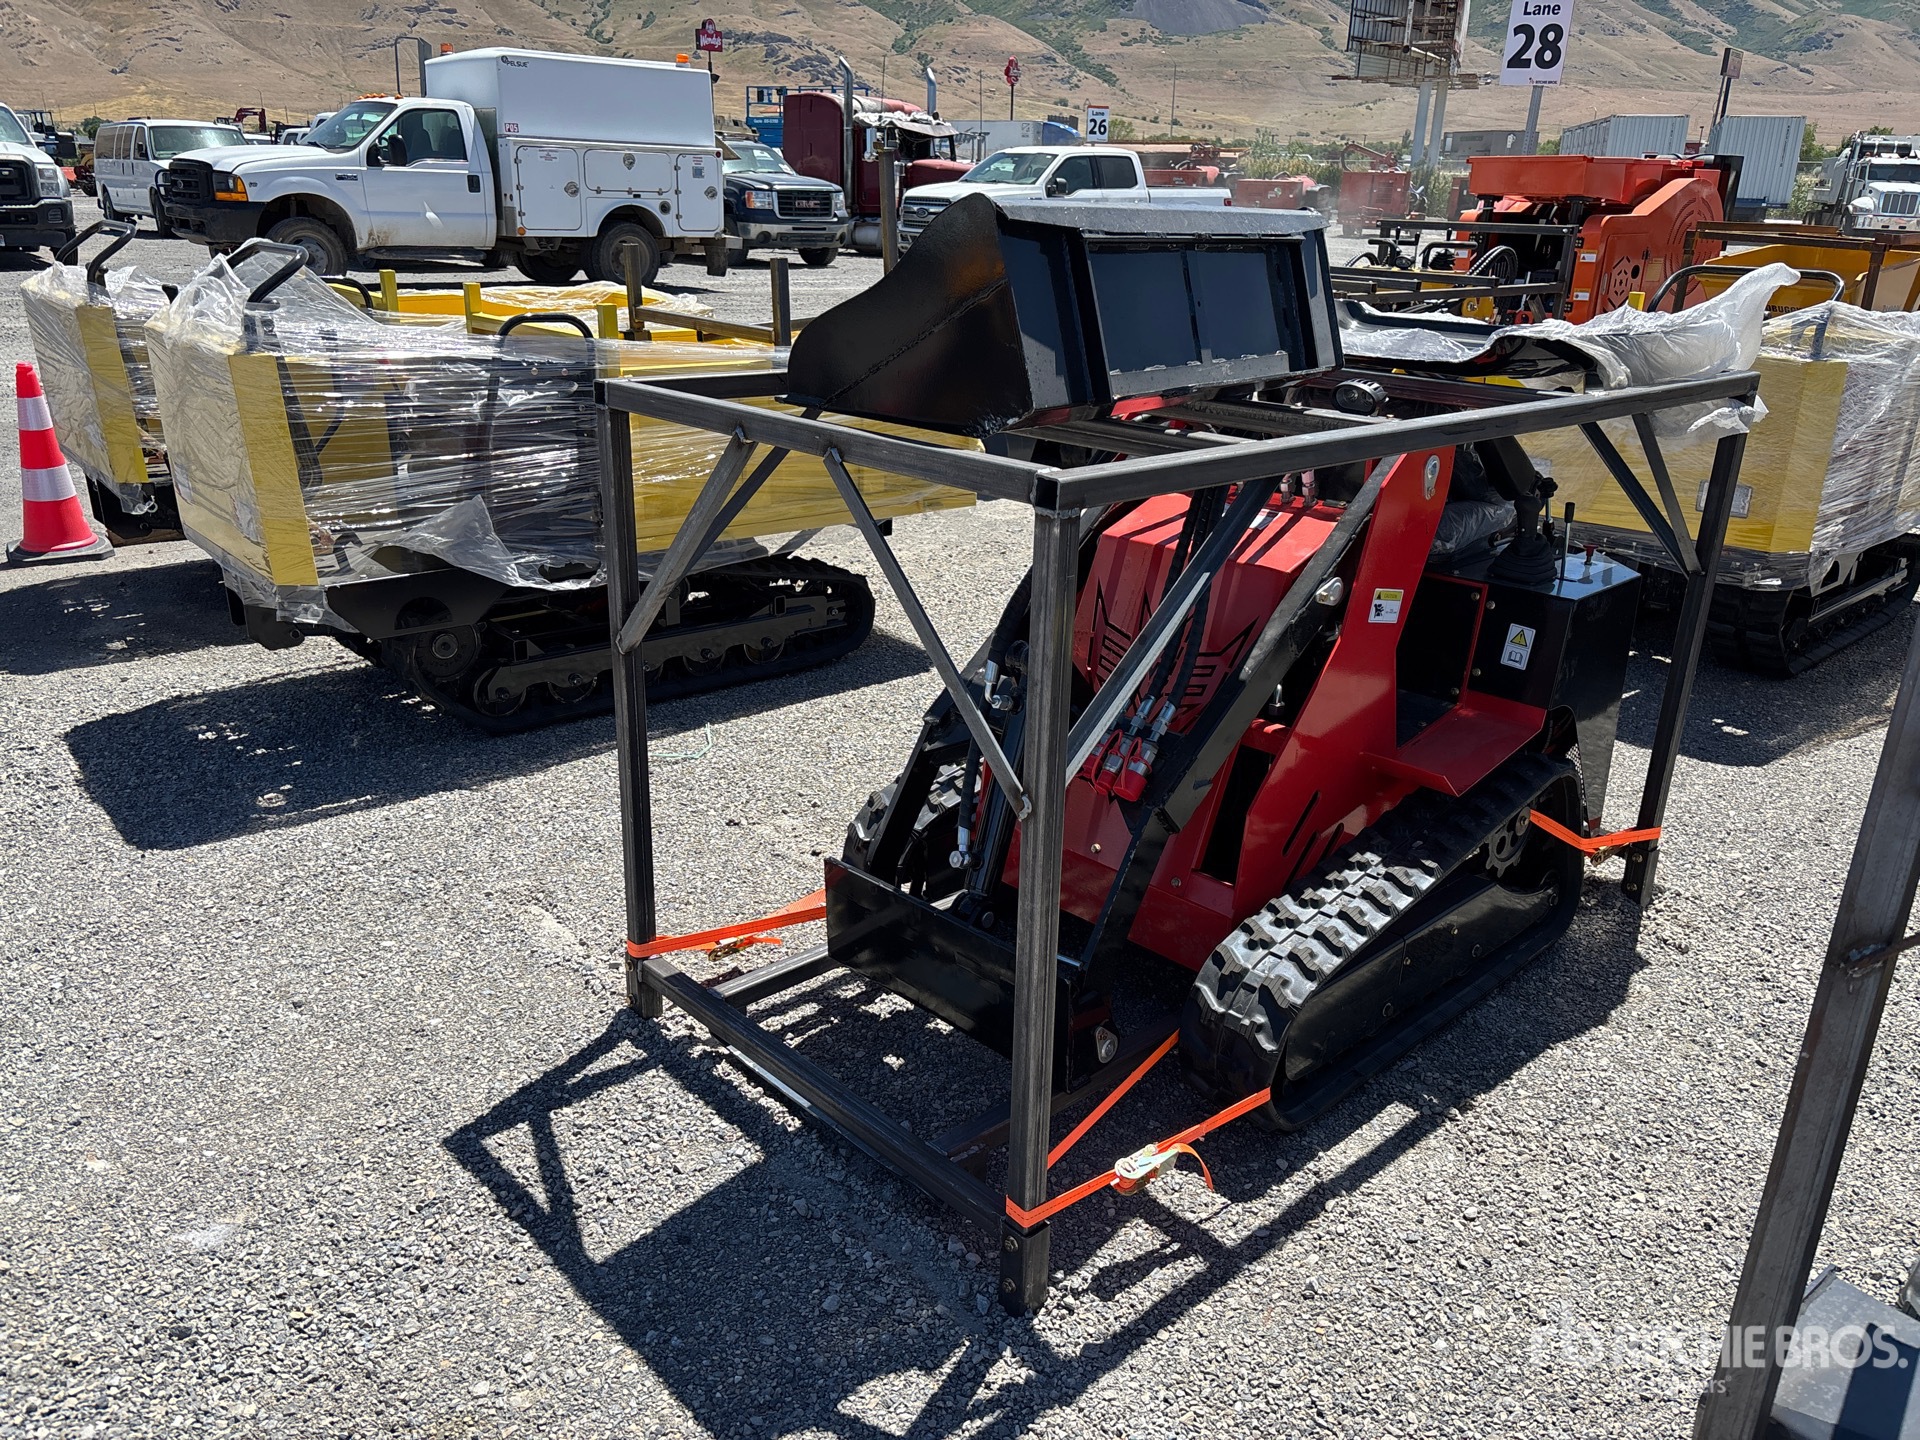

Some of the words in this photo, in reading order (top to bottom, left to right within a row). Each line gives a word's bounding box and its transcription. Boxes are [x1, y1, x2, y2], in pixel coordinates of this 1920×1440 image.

[1523, 1, 1561, 16] Lane
[1506, 23, 1564, 70] 28
[1088, 118, 1107, 136] 26
[795, 200, 820, 209] GMC
